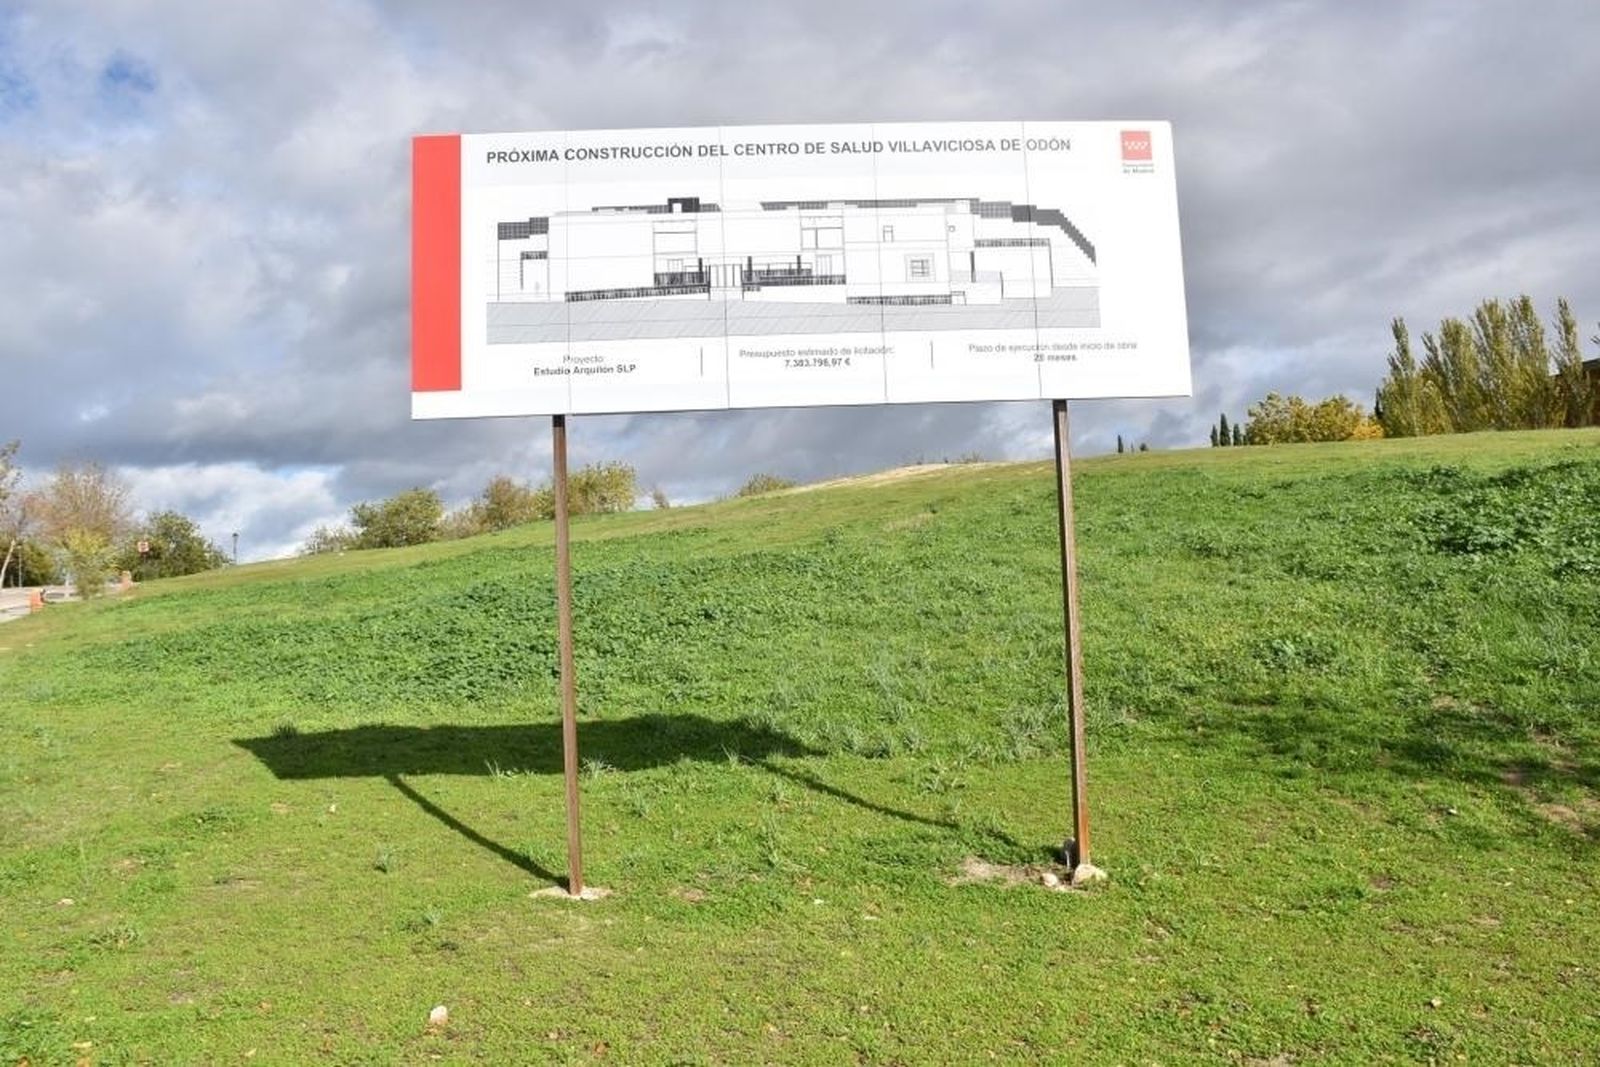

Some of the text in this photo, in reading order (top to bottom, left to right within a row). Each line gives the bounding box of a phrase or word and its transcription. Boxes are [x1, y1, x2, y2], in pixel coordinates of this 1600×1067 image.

[486, 135, 1072, 163] PRÓXIMA CONSTRUCCIÓN DEL CENTRO DE SALUD VILLAVICIOSA DE ODÓN
[616, 363, 637, 373] SLP
